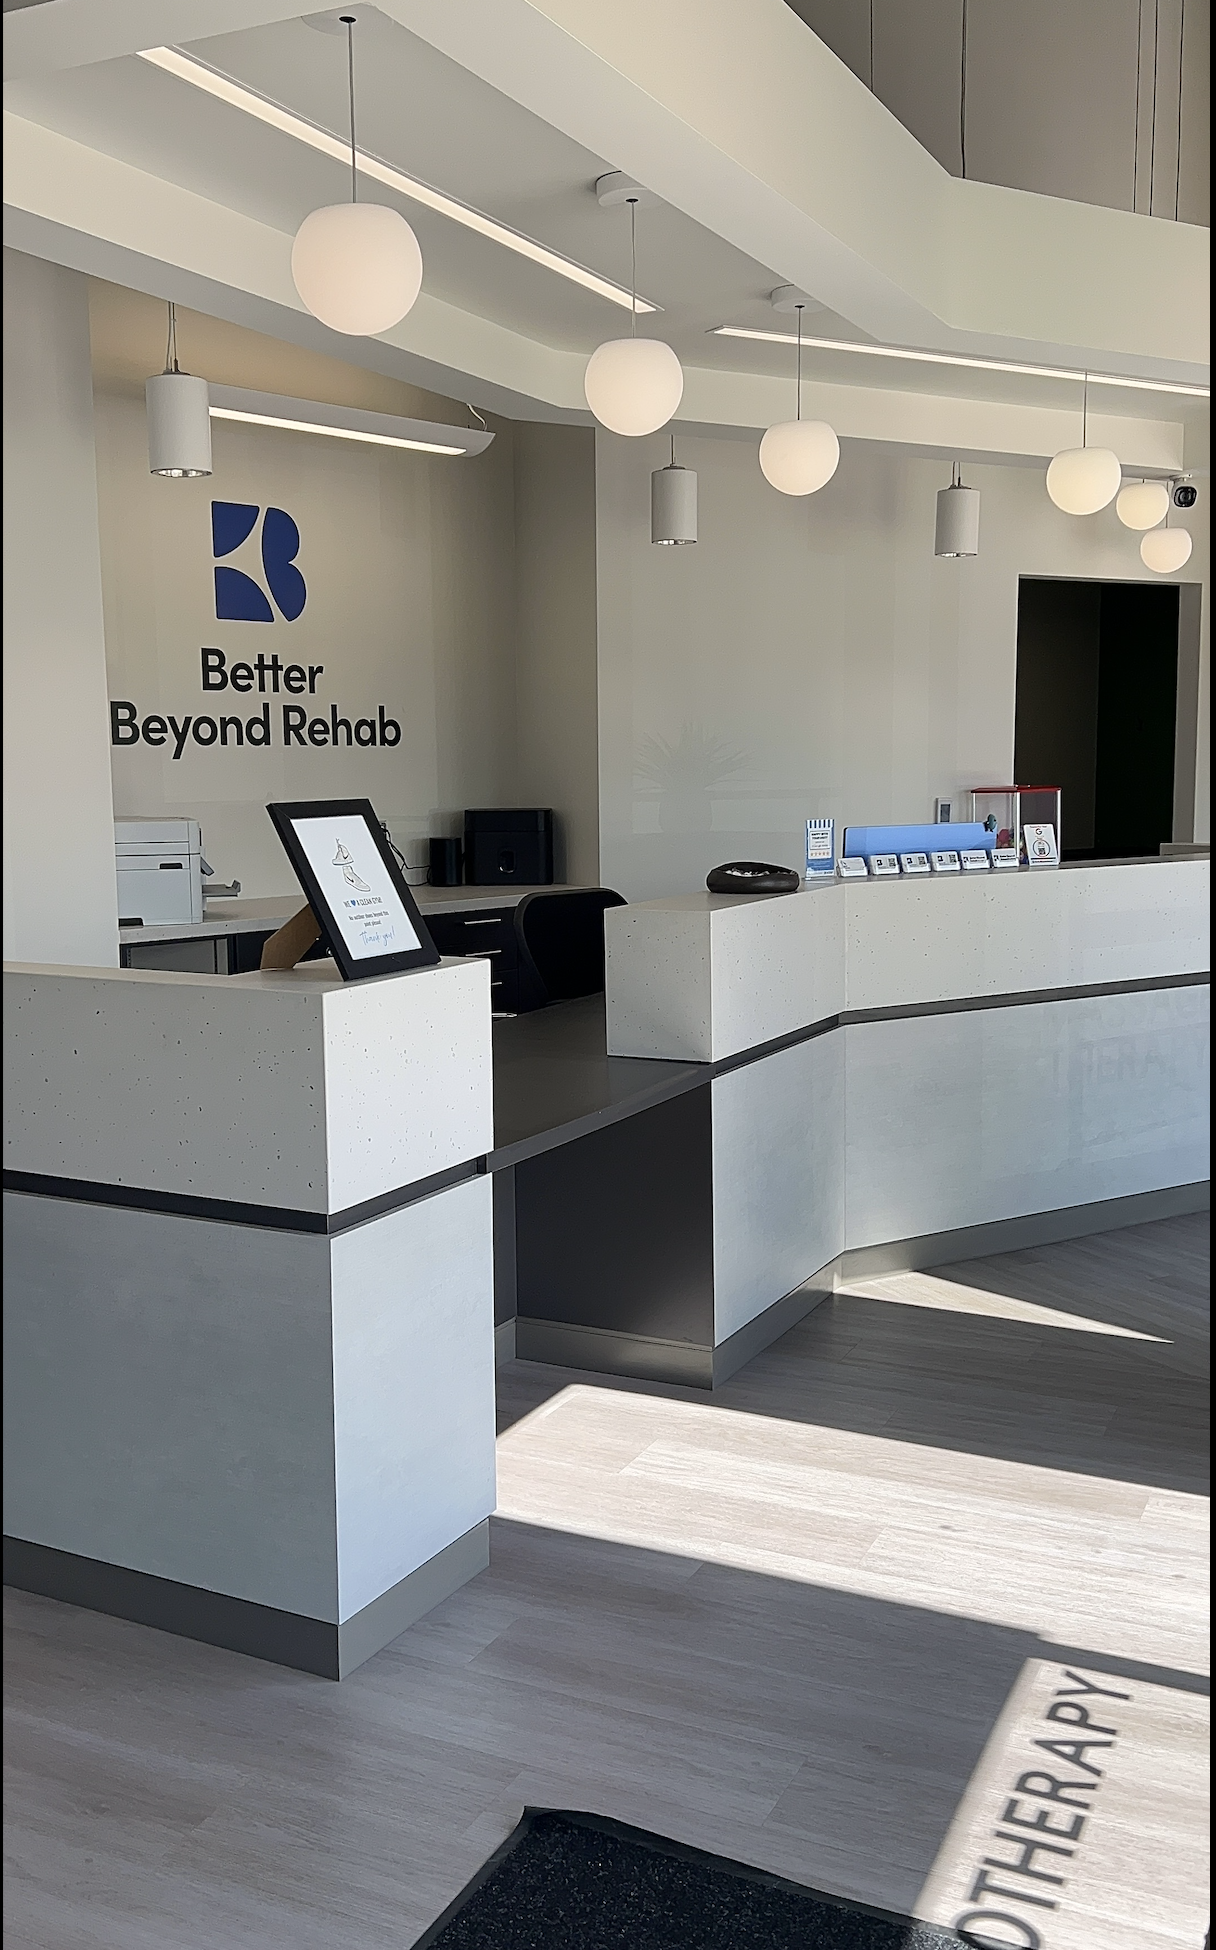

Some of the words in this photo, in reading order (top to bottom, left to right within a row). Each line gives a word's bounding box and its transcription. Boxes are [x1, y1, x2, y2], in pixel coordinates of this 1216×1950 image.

[200, 646, 325, 694] Better
[110, 699, 271, 760] Beyond
[282, 703, 402, 747] Rehab
[359, 930, 380, 946] Thank
